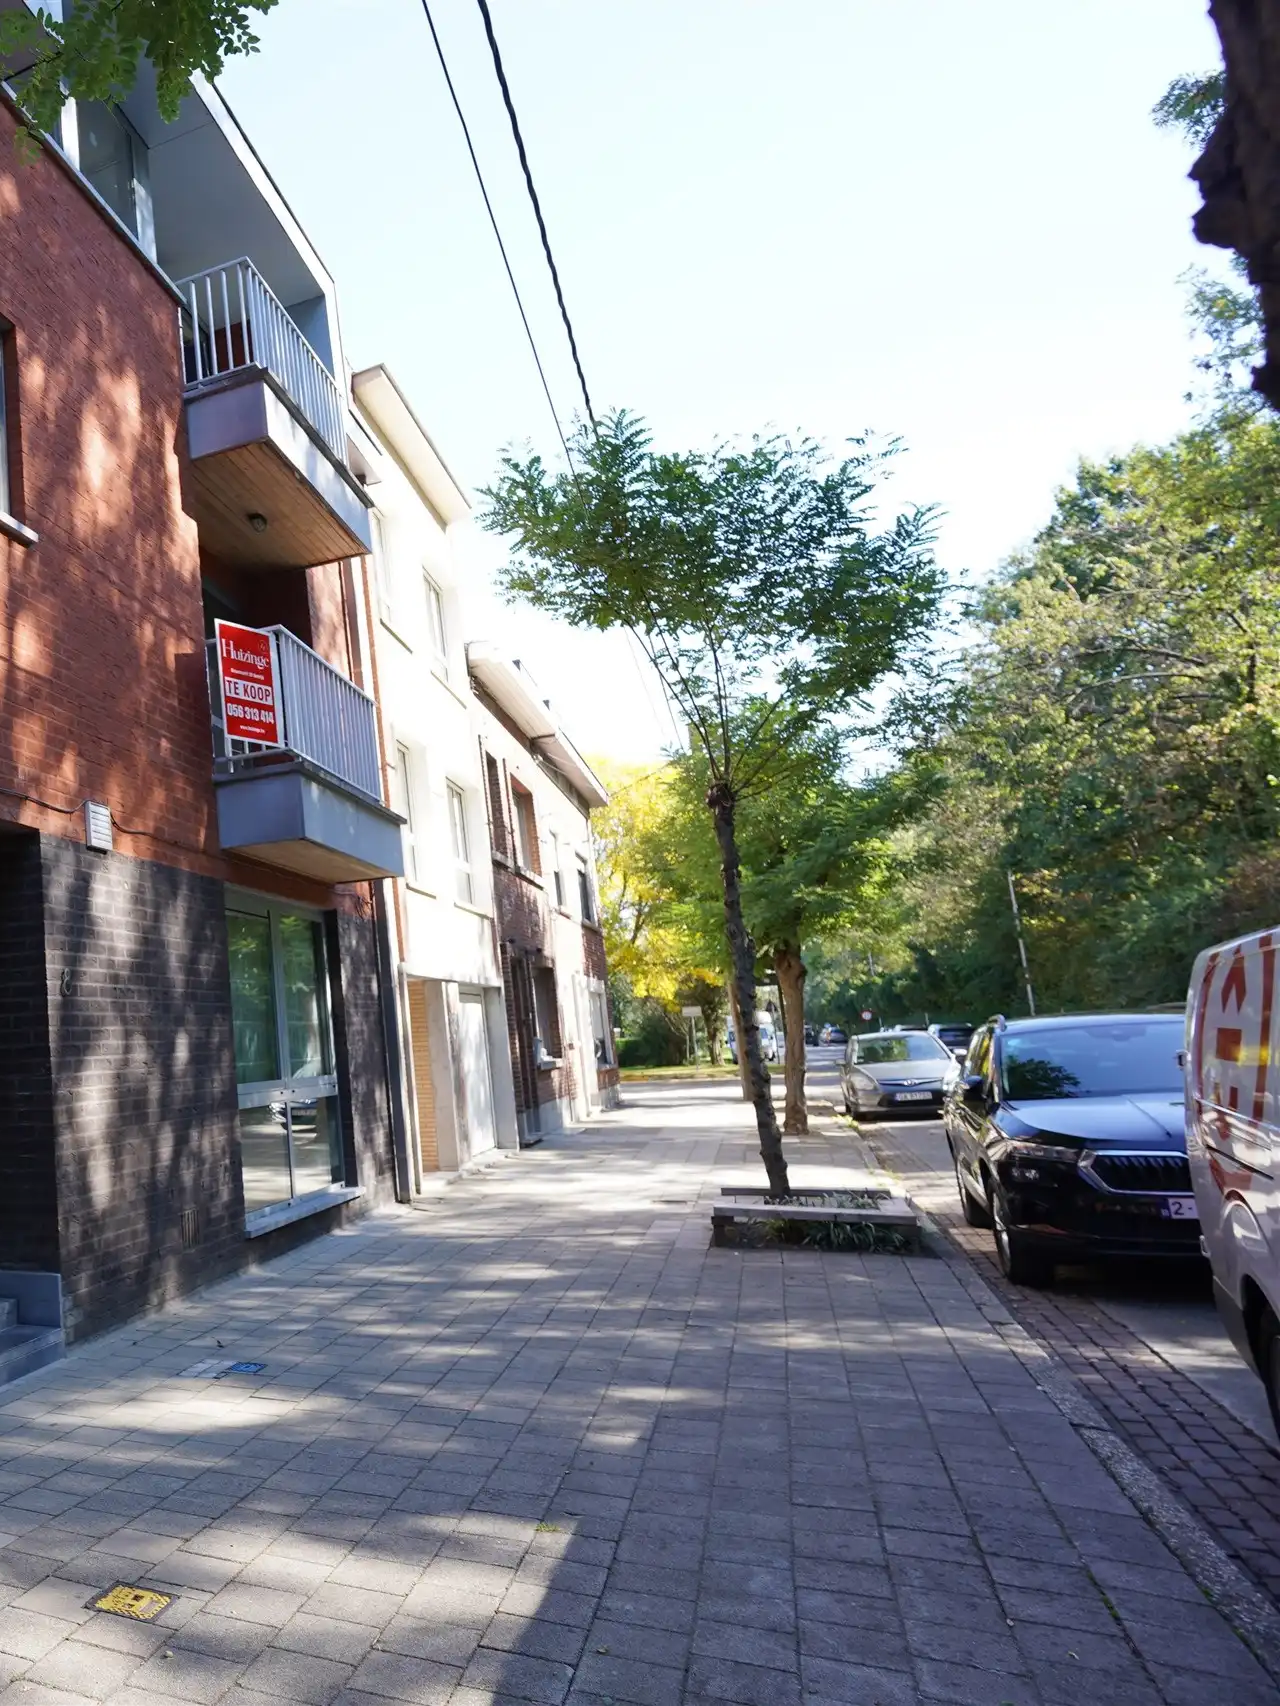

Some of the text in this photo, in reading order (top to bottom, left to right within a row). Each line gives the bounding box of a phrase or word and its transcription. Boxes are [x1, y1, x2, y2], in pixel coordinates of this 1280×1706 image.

[221, 638, 270, 670] Huizinge
[226, 680, 270, 702] TE KOOP
[227, 703, 274, 724] 056 313 414
